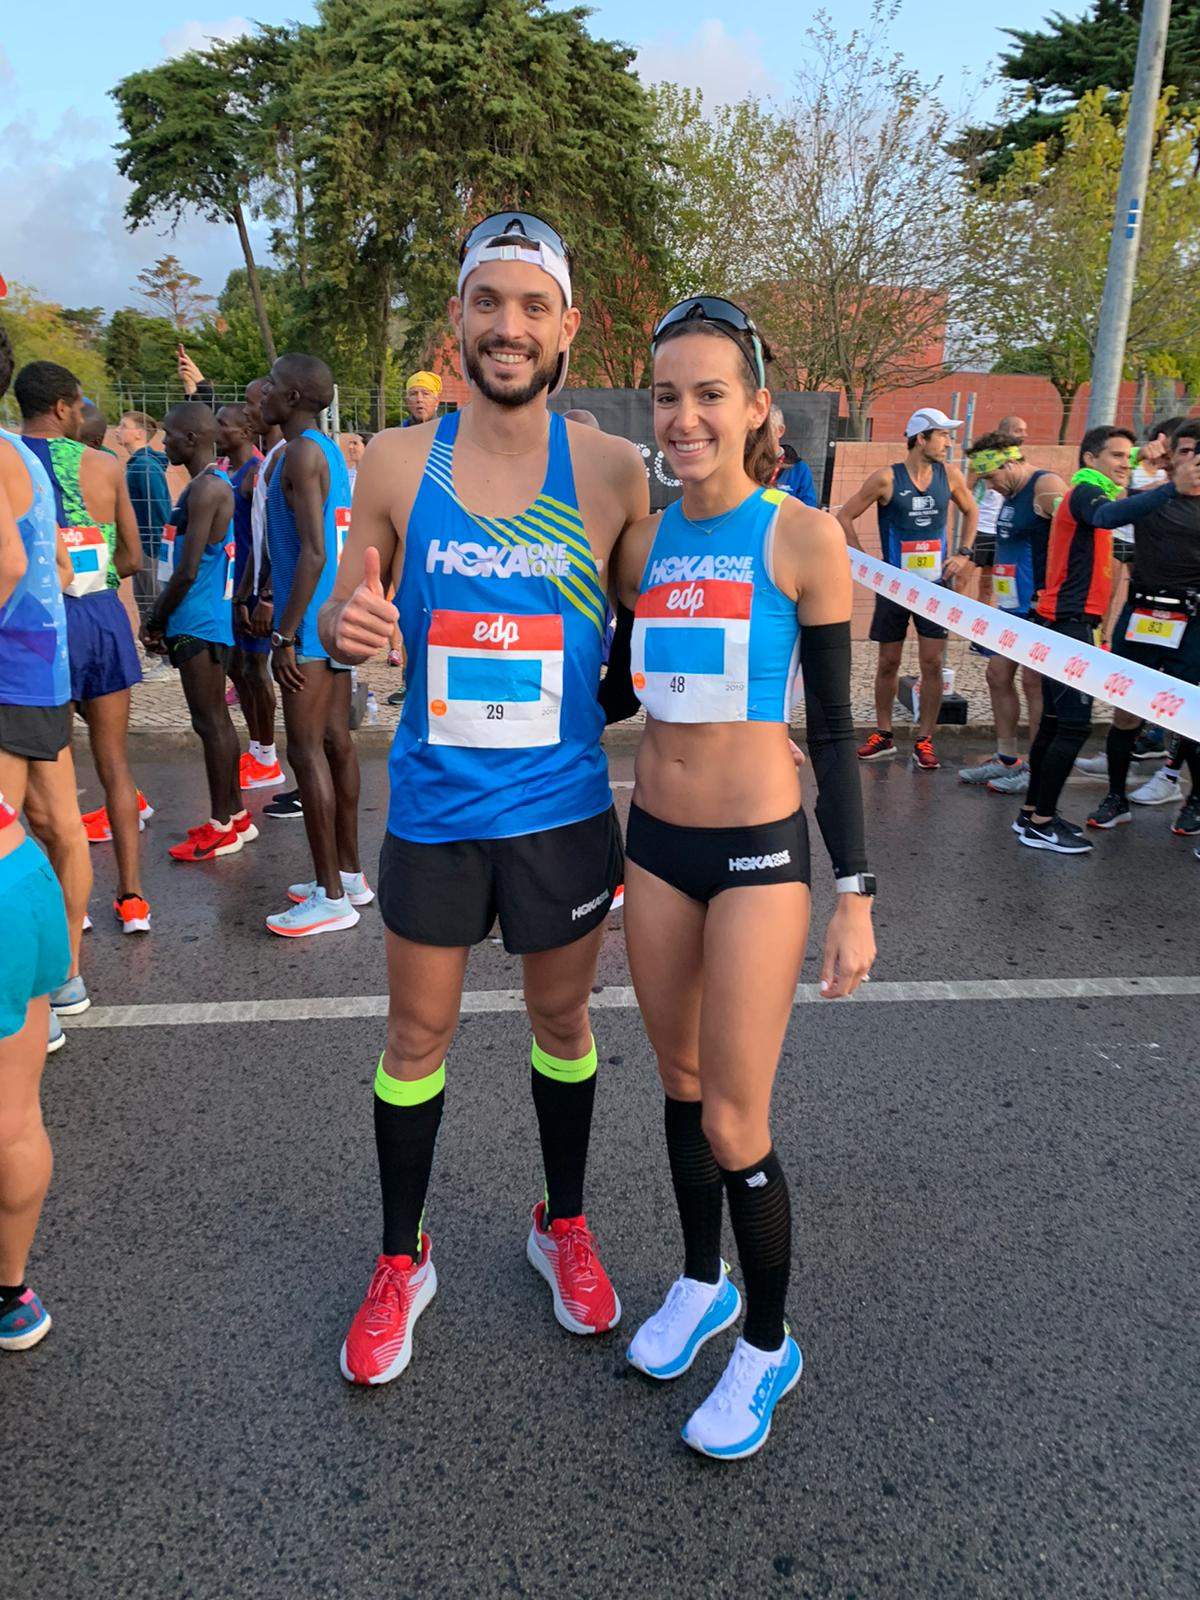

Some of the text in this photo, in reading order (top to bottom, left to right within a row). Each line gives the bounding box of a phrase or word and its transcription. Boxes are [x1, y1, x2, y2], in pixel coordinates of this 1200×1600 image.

[426, 539, 568, 578] HOKA ONE
[530, 560, 572, 577] ONE
[648, 555, 754, 586] HOKA ONE
[715, 569, 755, 583] ONE
[666, 582, 705, 617] edp
[472, 615, 519, 650] edp
[670, 676, 685, 693] 48
[486, 704, 504, 720] 29
[728, 855, 775, 871] HOKA
